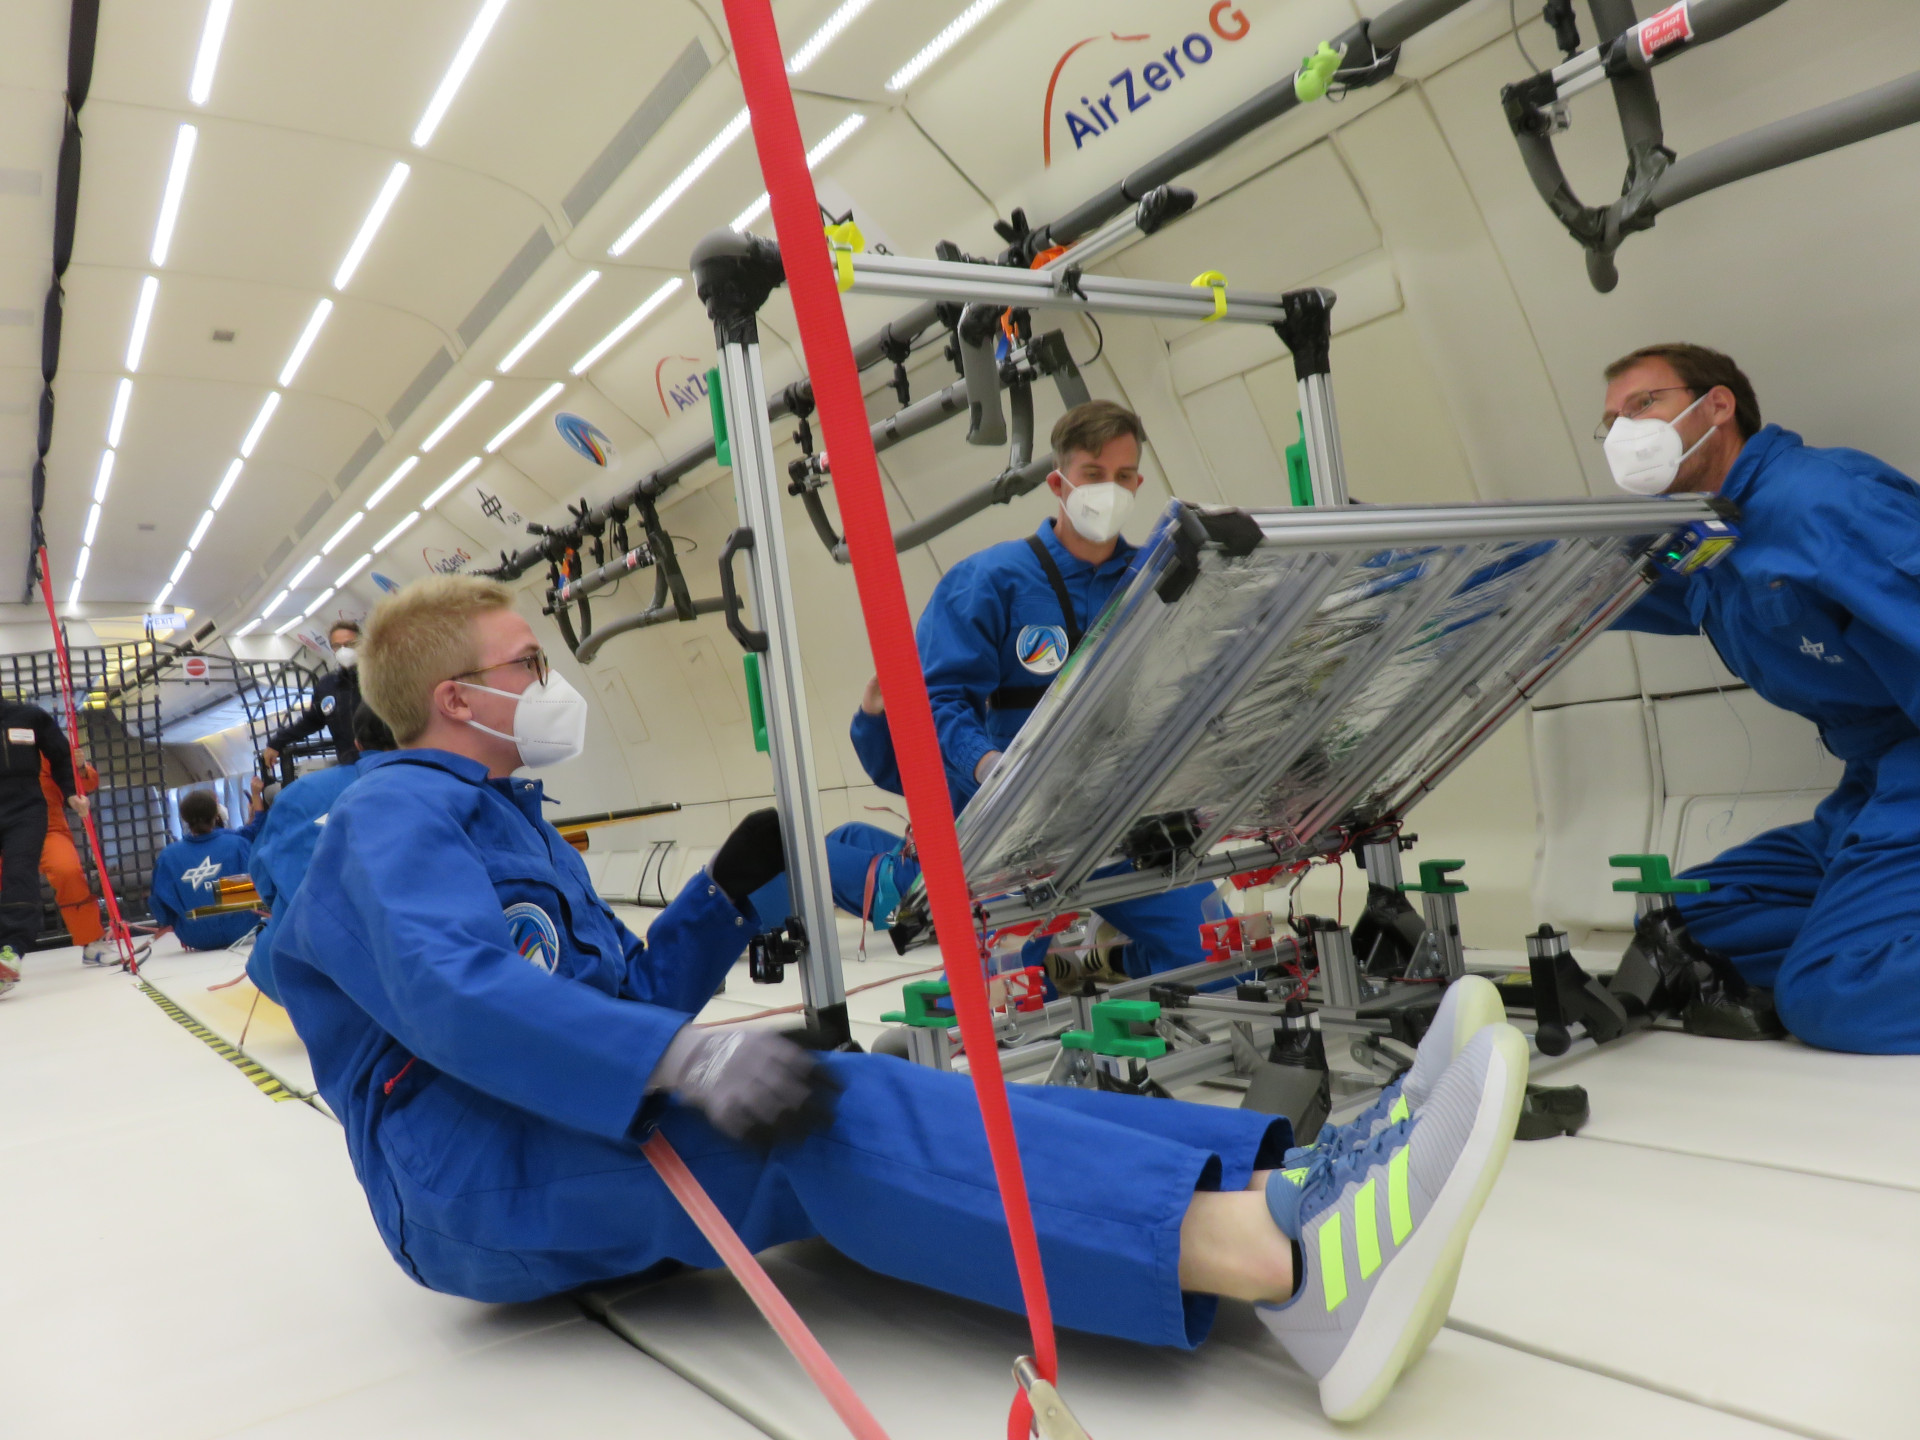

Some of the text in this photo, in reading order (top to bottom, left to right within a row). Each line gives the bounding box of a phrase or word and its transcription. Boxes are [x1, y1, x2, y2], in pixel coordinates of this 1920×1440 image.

[1645, 14, 1681, 39] Do not
[1649, 28, 1681, 49] touch
[154, 617, 174, 625] EXIT
